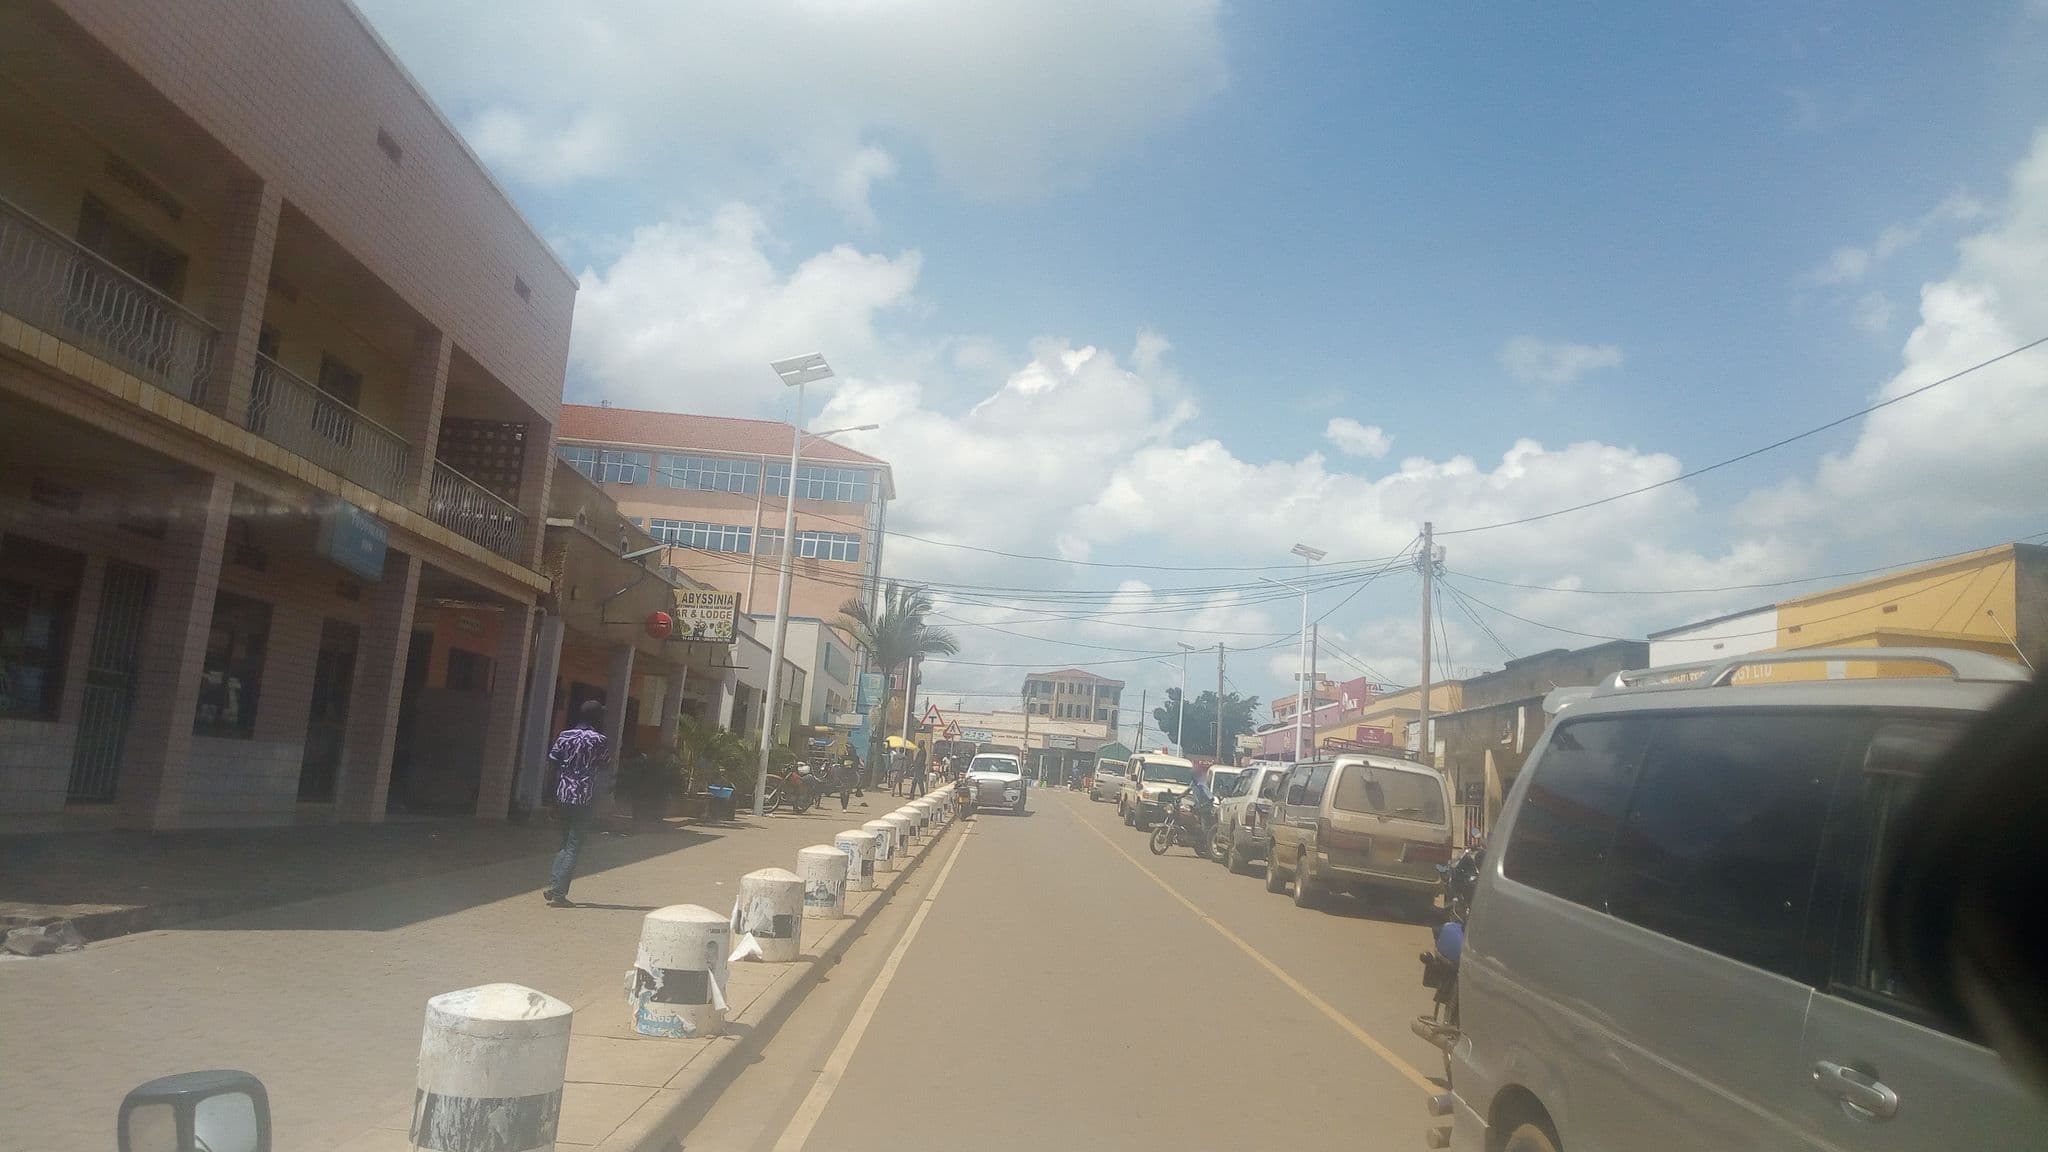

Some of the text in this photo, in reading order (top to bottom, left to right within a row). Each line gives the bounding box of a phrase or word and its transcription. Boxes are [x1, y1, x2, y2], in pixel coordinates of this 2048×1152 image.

[682, 593, 734, 605] ABYSSINIA
[691, 609, 698, 618] &
[701, 610, 733, 619] LODGE
